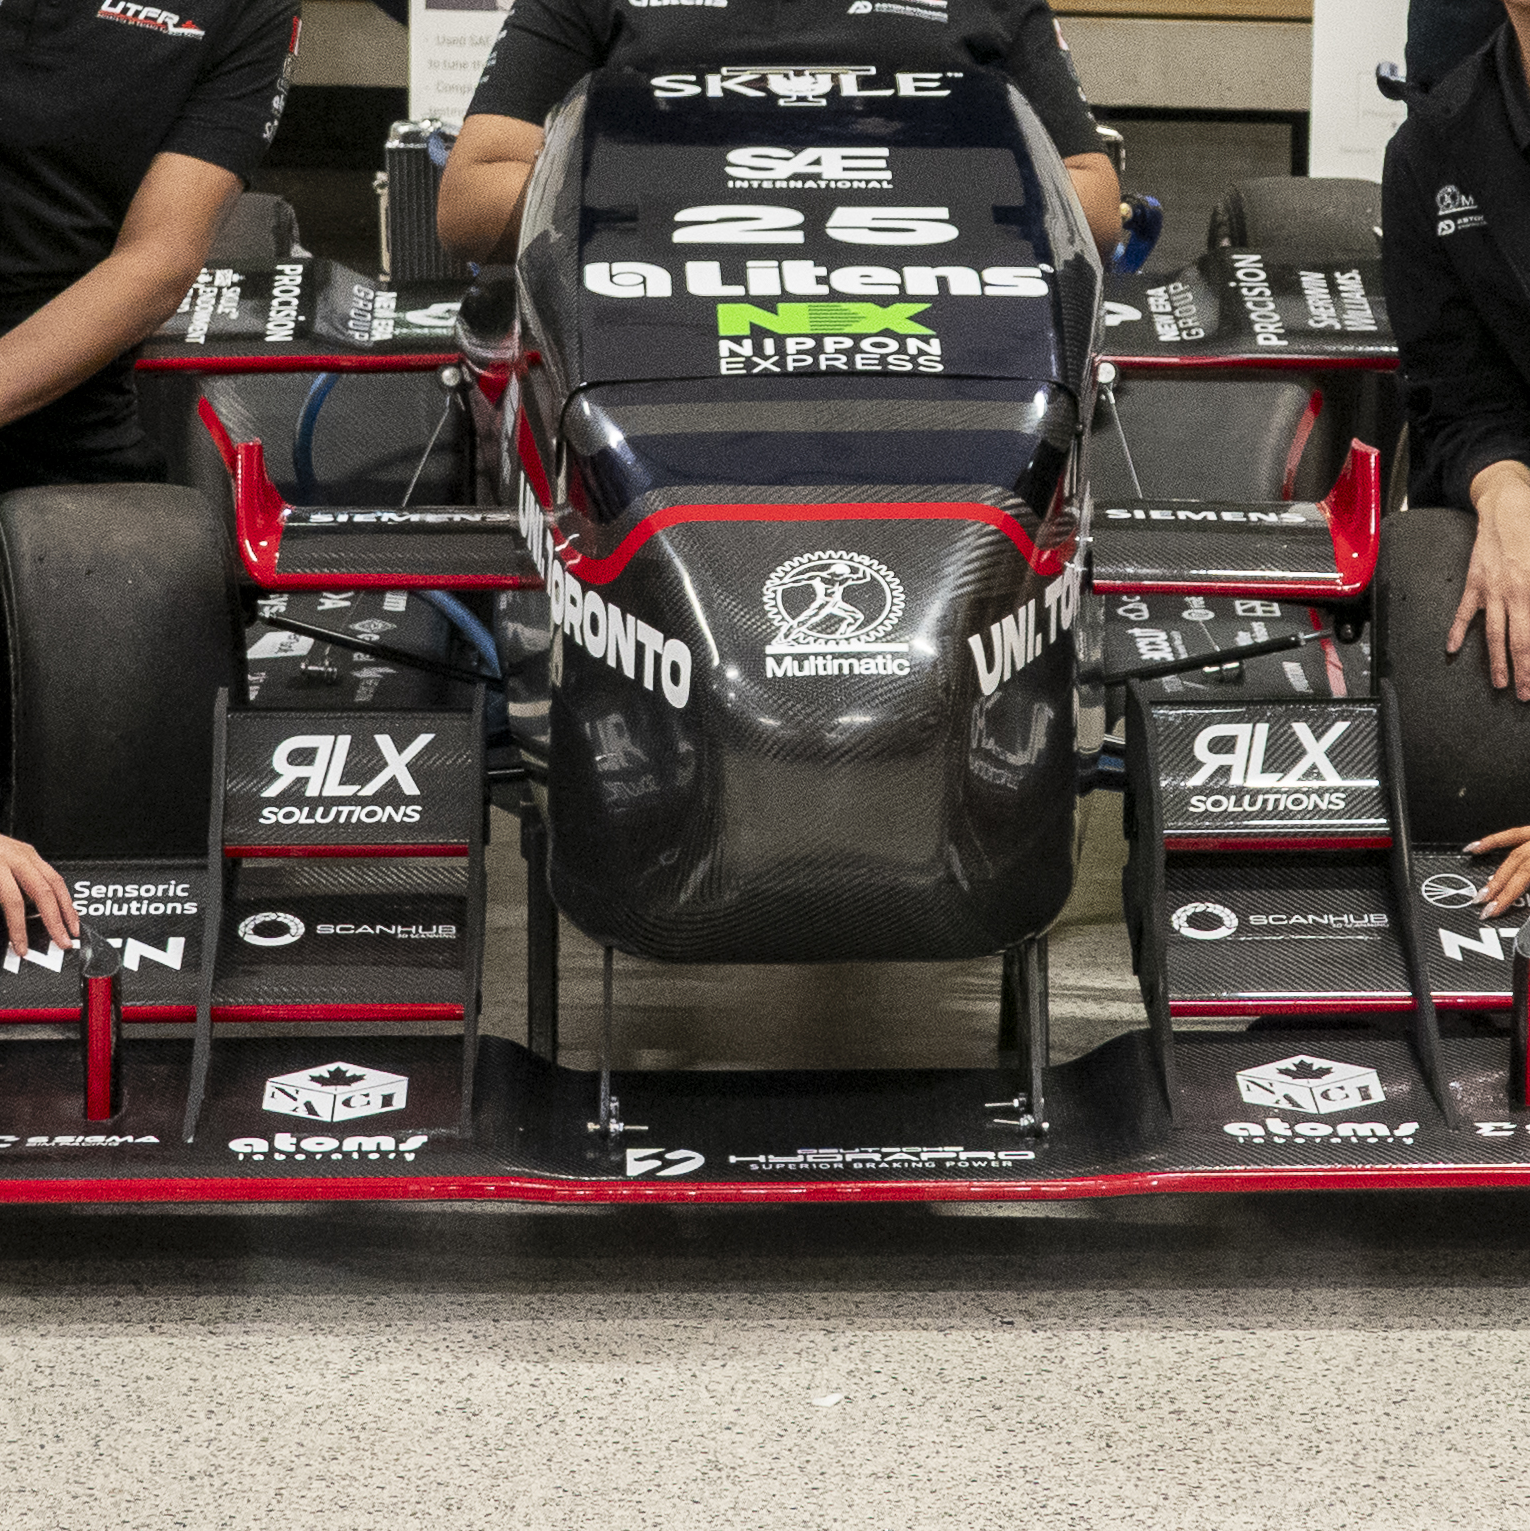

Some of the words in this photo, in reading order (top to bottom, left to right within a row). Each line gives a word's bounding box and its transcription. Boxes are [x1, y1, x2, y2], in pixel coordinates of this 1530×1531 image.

[725, 147, 893, 180] SAE
[727, 178, 894, 189] INTERNATIONAL
[672, 205, 960, 245] 25
[686, 259, 1052, 297] Litens
[719, 337, 942, 357] NIPPON
[719, 354, 945, 375] EXPRESS
[1104, 507, 1307, 524] SIEMENS
[546, 528, 692, 710] TORONTO
[967, 597, 1043, 697] UNI.
[765, 653, 911, 678] Multimatic
[1187, 792, 1348, 813] SOLUTIONS
[258, 804, 423, 825] SOLUTIONS
[73, 880, 190, 899] Sensoric
[71, 898, 199, 917] Solutions
[316, 923, 457, 935] SCANHUB
[1249, 913, 1389, 925] SCANHUB
[1222, 1117, 1421, 1137] atoms
[228, 1132, 429, 1153] atoms
[729, 1150, 1036, 1164] HYDRAPRO
[749, 1162, 845, 1170] SUPERIOR
[853, 1160, 937, 1169] BRAKING
[946, 1159, 1014, 1168] POWER
